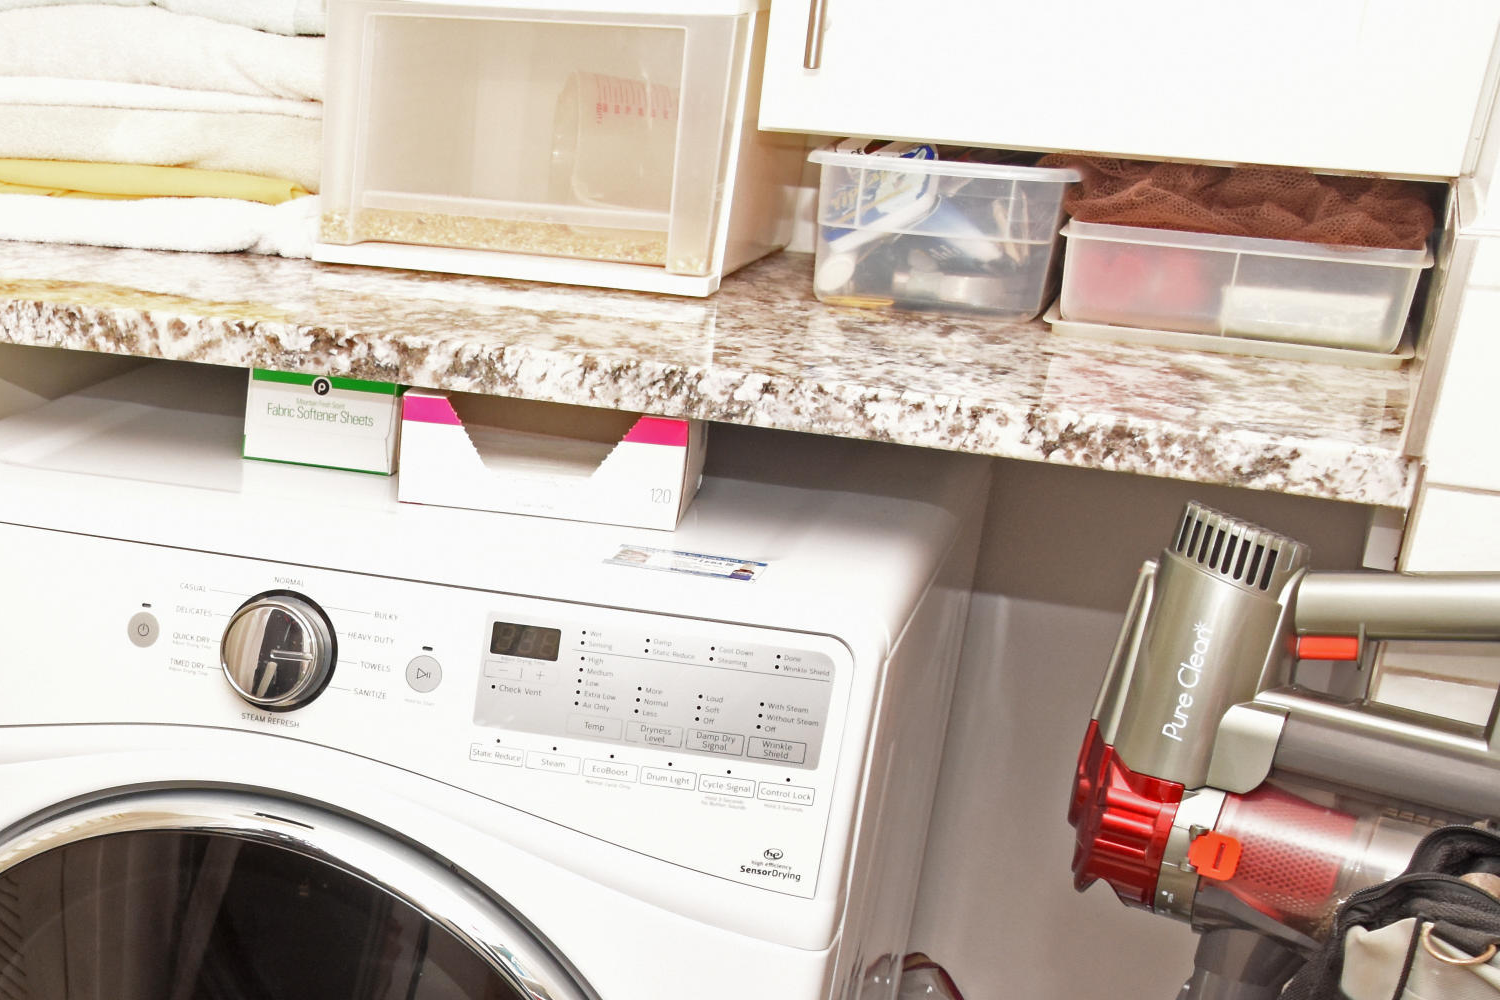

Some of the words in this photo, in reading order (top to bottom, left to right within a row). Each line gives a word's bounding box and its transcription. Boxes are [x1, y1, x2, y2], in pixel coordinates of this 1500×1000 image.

[267, 402, 295, 418] Fabric
[297, 405, 338, 422] Softener
[340, 410, 374, 427] Sheets
[651, 487, 671, 505] 120
[180, 582, 206, 593] CASUAL
[274, 576, 304, 587] NORMAL
[176, 605, 212, 617] DELICATES
[374, 611, 399, 621] BULKY
[173, 632, 195, 641] QUICK
[196, 633, 211, 644] DRY
[348, 632, 372, 642] HEAVY
[374, 634, 395, 645] DUTY
[170, 658, 190, 667] TIMED
[191, 660, 205, 670] DRY
[588, 656, 604, 666] High
[1177, 627, 1211, 690] Clean
[360, 661, 391, 673] TOWELS
[587, 668, 614, 678] Medium
[783, 664, 807, 674] Wrinkle
[809, 668, 831, 678] Shield
[585, 679, 599, 688] Low
[354, 687, 387, 700] SANITIZE
[499, 684, 521, 694] Check
[525, 688, 542, 697] Vent
[584, 691, 602, 700] Extra
[602, 693, 616, 701] Low
[645, 687, 663, 696] More
[643, 698, 669, 708] Normal
[706, 695, 724, 704] Loud
[593, 703, 610, 713] Only
[642, 709, 658, 718] Less
[705, 706, 720, 714] Soft
[768, 702, 784, 711] With
[786, 704, 809, 714] Steam
[241, 712, 266, 723] STEAM
[268, 716, 300, 728] REFRESH
[703, 716, 715, 725] Off
[766, 714, 794, 725] Without
[796, 717, 820, 727] Steam
[1161, 690, 1194, 742] Pure
[584, 721, 605, 733] Temp
[640, 724, 672, 737] Dryness
[764, 725, 777, 734] Off
[644, 734, 665, 744] Level
[696, 732, 719, 743] Damp
[721, 735, 736, 746] Dry
[702, 741, 727, 752] Signal
[762, 740, 793, 751] Wrinkle
[473, 748, 493, 758] Static
[494, 751, 521, 762] Reduce
[763, 749, 789, 760] Shield
[541, 758, 566, 768] Steam
[592, 765, 628, 777] EcoBoost
[646, 773, 668, 782] Drum
[670, 776, 690, 786] Light
[702, 780, 724, 789] Cycle
[726, 783, 751, 793] Signal
[760, 788, 790, 798] Control
[793, 792, 812, 801] Lock
[740, 865, 802, 882] SensorDrying
